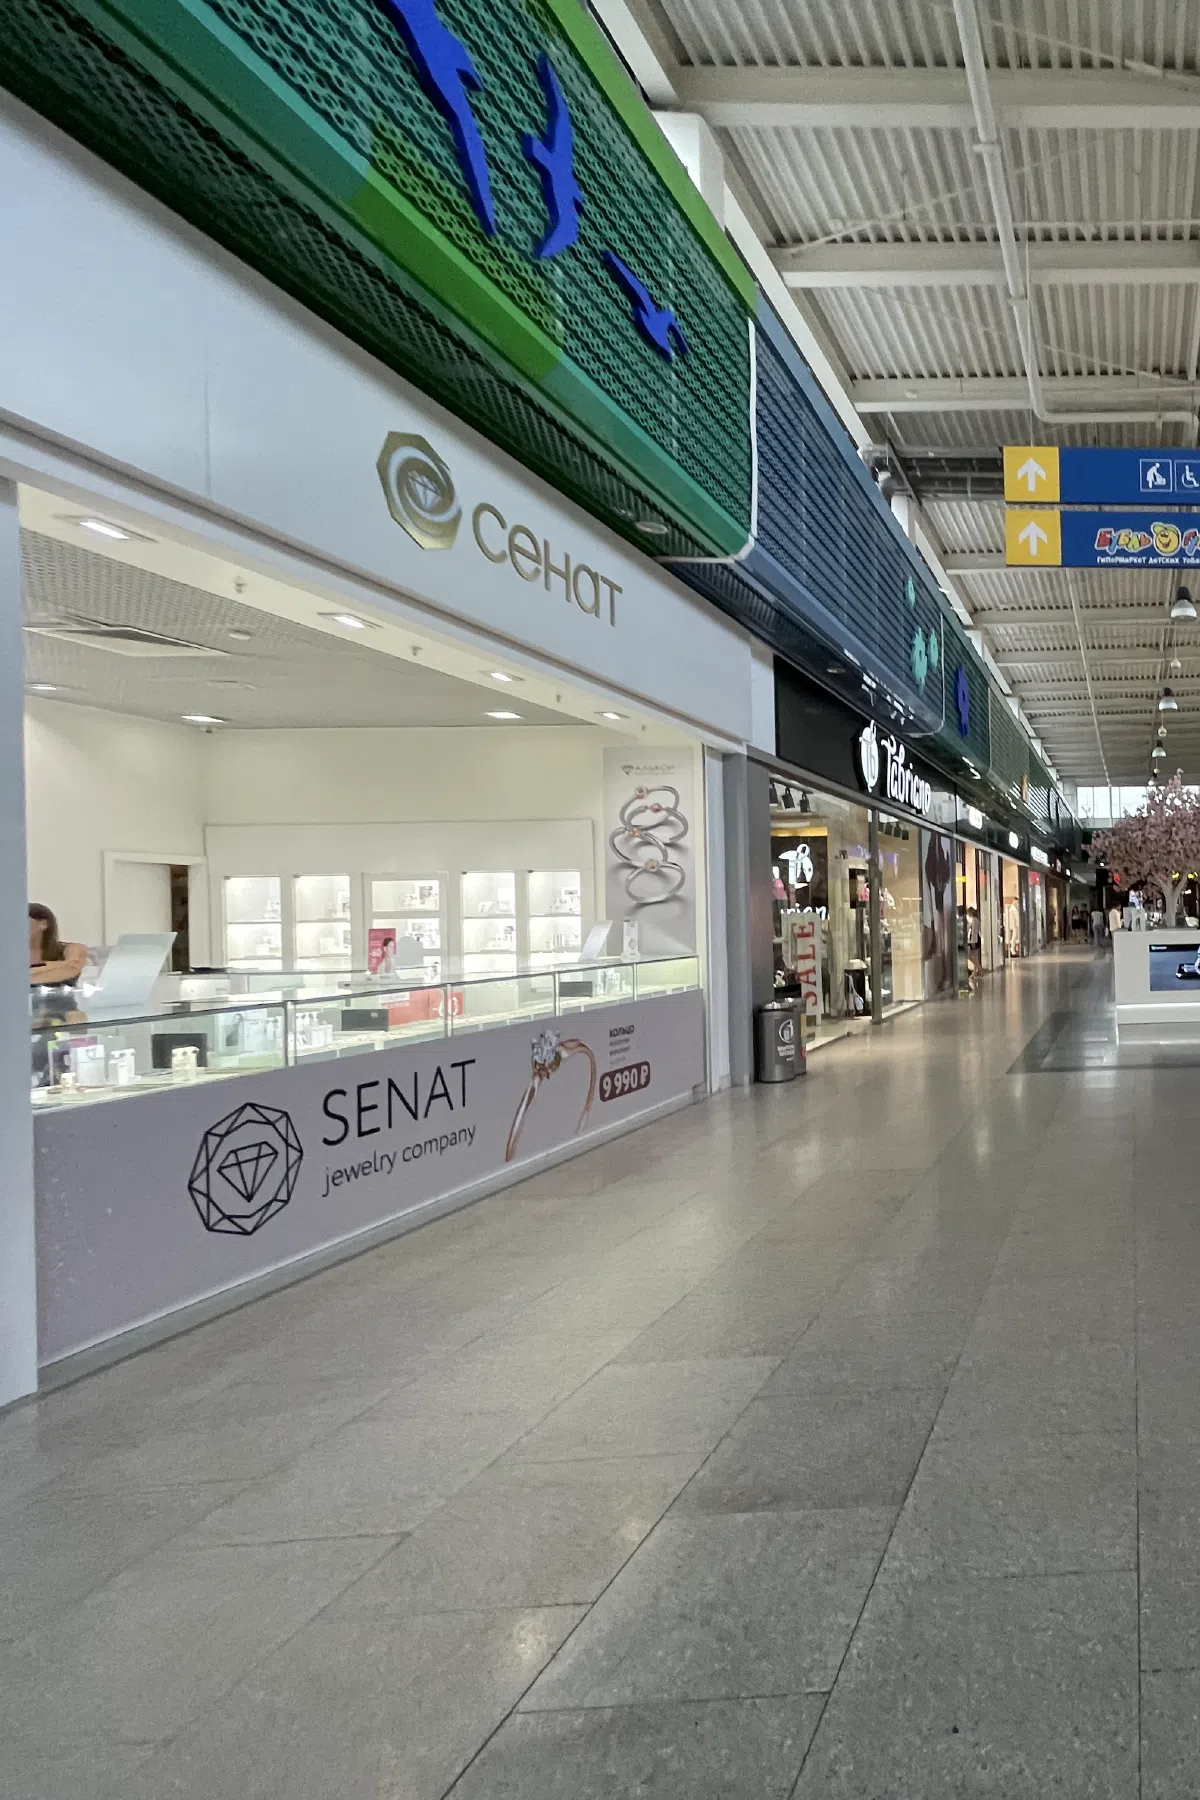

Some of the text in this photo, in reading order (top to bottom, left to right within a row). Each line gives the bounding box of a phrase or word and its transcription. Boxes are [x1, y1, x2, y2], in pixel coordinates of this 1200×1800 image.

[322, 1058, 476, 1146] SENAT
[602, 1075, 612, 1098] 9
[613, 1068, 638, 1096] 990
[321, 1125, 476, 1198] jewelry company
